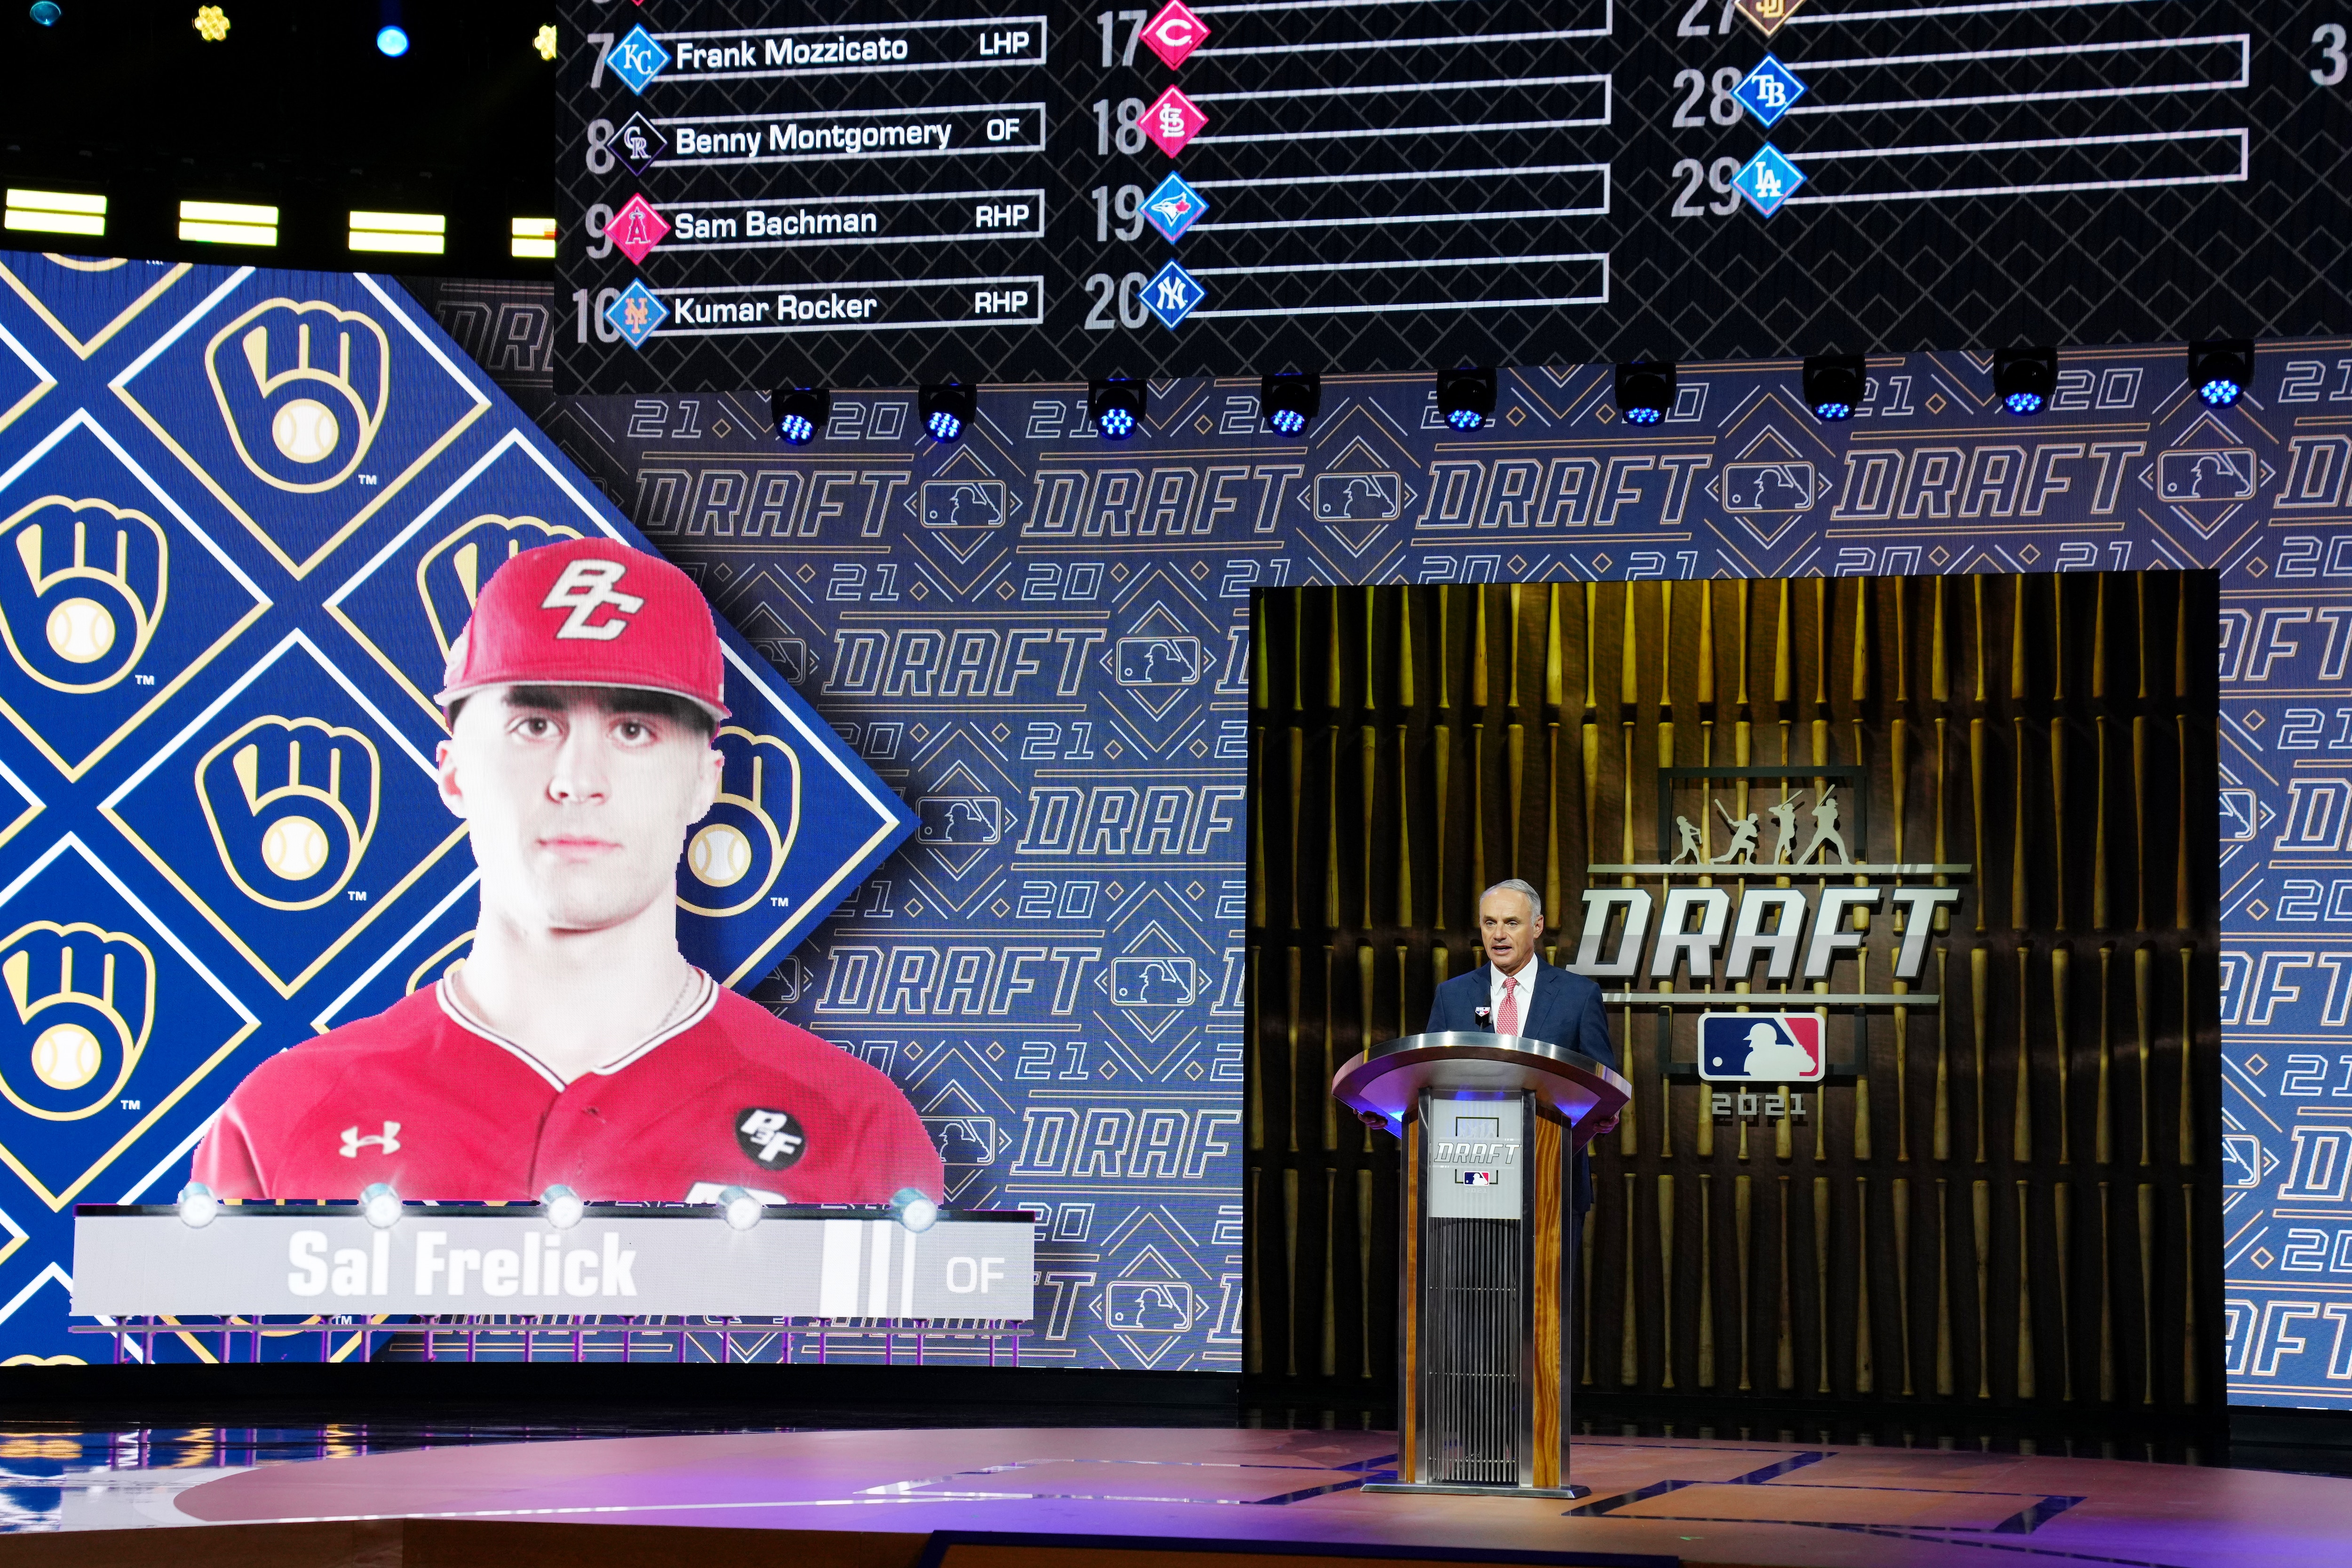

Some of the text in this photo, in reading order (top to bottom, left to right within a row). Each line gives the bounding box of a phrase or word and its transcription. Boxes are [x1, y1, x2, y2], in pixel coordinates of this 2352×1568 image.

[587, 33, 614, 88] 7
[677, 40, 756, 70] Frank
[765, 34, 908, 65] Mozzicato
[979, 32, 1029, 55] LHP
[1097, 11, 1147, 67] 17
[1672, 66, 1744, 128] 28
[586, 118, 614, 174] 8
[676, 128, 761, 158] Benny
[769, 122, 952, 153] Montgomery
[986, 118, 1019, 141] OF
[1093, 98, 1146, 155] 18
[1092, 185, 1144, 242] 19
[1671, 156, 1743, 217] 29
[585, 204, 613, 259] 9
[675, 213, 737, 239] Sam
[747, 208, 877, 236] Bachman
[975, 204, 1029, 228] RHP
[572, 287, 621, 344] 10
[675, 298, 770, 324] Kumar
[777, 294, 877, 321] Rocker
[974, 291, 1028, 314] RHP
[1084, 272, 1148, 330] 20
[628, 400, 701, 438] 21
[826, 402, 908, 440] 20
[631, 468, 912, 537] DRAFT
[1021, 465, 1304, 537] DRAFT
[1415, 454, 1713, 530] DRAFT
[1830, 442, 2146, 519] DRAFT
[826, 564, 900, 601] 21
[1022, 563, 1104, 601] 20
[821, 629, 1106, 696] DRAFT
[1021, 722, 1094, 760] 21
[1017, 881, 1098, 919] 20
[1565, 887, 1959, 979] DRAFT
[815, 947, 1102, 1015] DRAFT
[1015, 1042, 1089, 1080] 21
[1712, 1093, 1806, 1116] 2021
[1434, 1142, 1521, 1164] DRAFT
[288, 1231, 636, 1297] Sal Frelick
[946, 1257, 1005, 1294] OF
